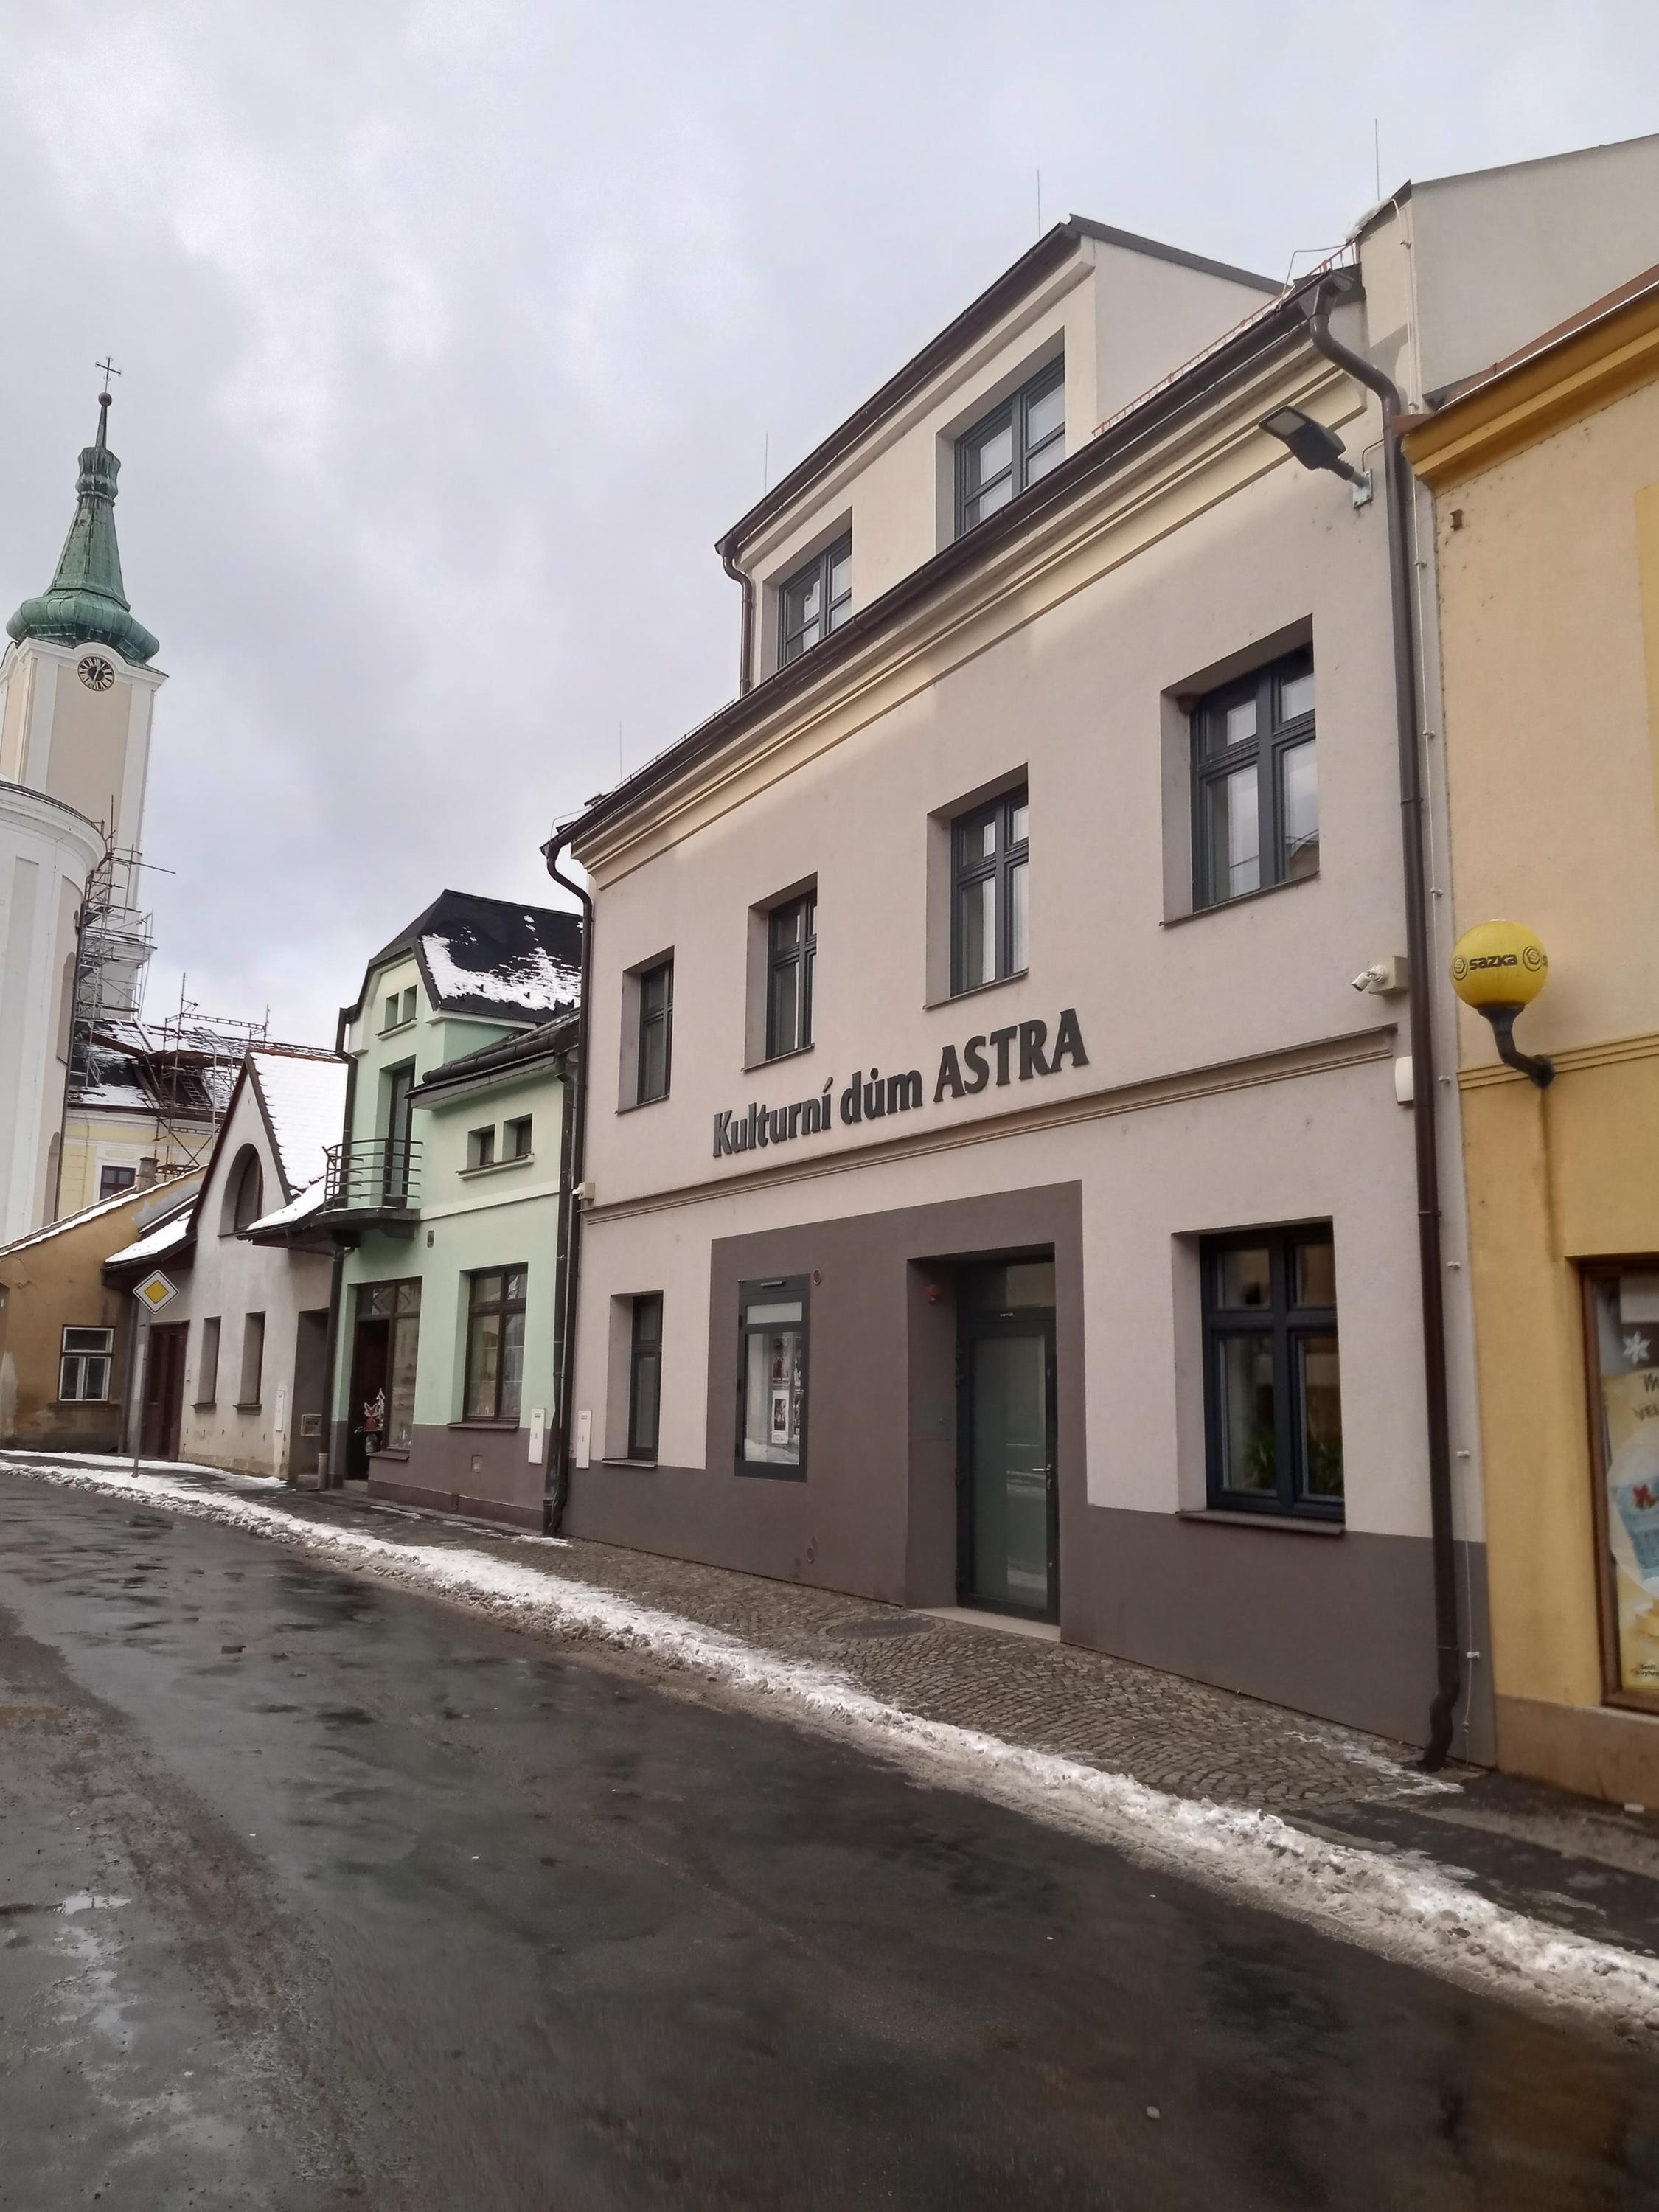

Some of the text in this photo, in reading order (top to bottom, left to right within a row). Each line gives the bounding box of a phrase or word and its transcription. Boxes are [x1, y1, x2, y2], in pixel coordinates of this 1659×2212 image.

[713, 1007, 1090, 1158] Kulturní dům ASTRA
